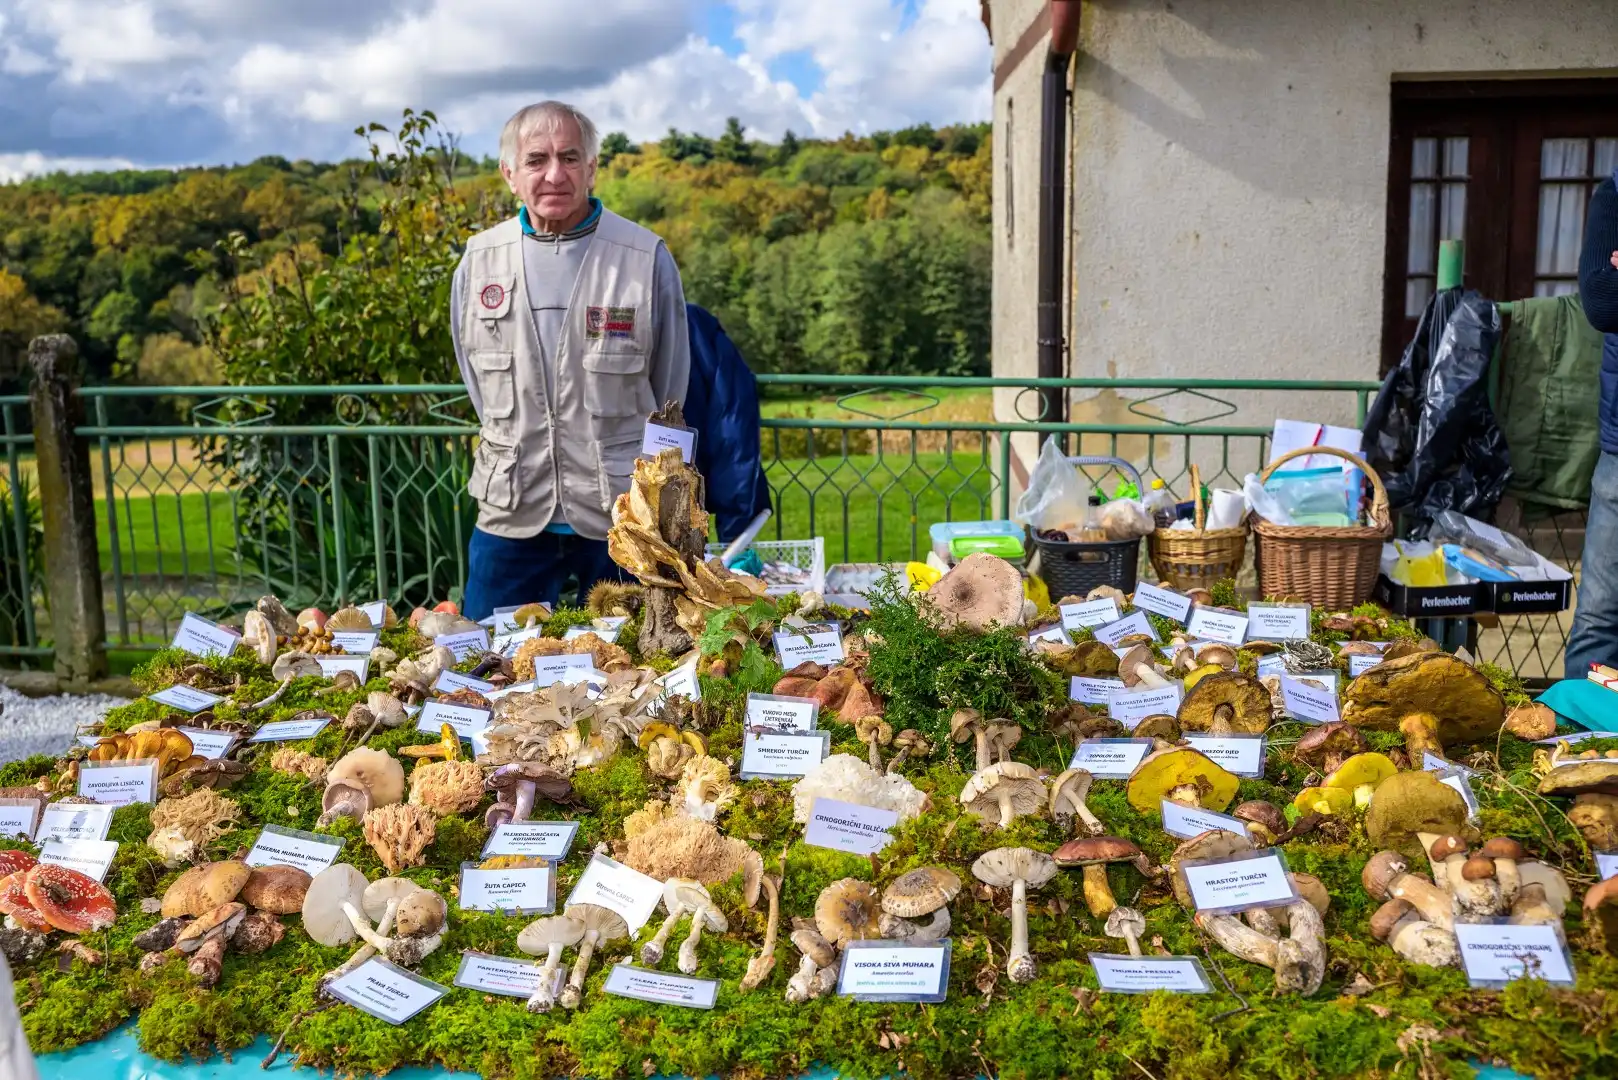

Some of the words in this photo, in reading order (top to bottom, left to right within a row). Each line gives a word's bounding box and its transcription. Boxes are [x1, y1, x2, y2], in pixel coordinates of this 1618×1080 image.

[1422, 596, 1471, 608] Perlenbacher
[1513, 591, 1557, 601] Perlenbacher
[815, 814, 861, 829] CRNOGORIČNI
[256, 844, 281, 854] BISERNA
[281, 850, 305, 859] MUHARA
[1205, 877, 1239, 886] HRASTOV
[1239, 872, 1268, 881] TURČIN
[477, 965, 518, 975] PANTEROVA
[366, 976, 386, 989] PRAVA
[386, 985, 410, 1000] TIGRICA
[629, 977, 658, 986] ZELENA
[659, 982, 695, 990] PUPAVKA
